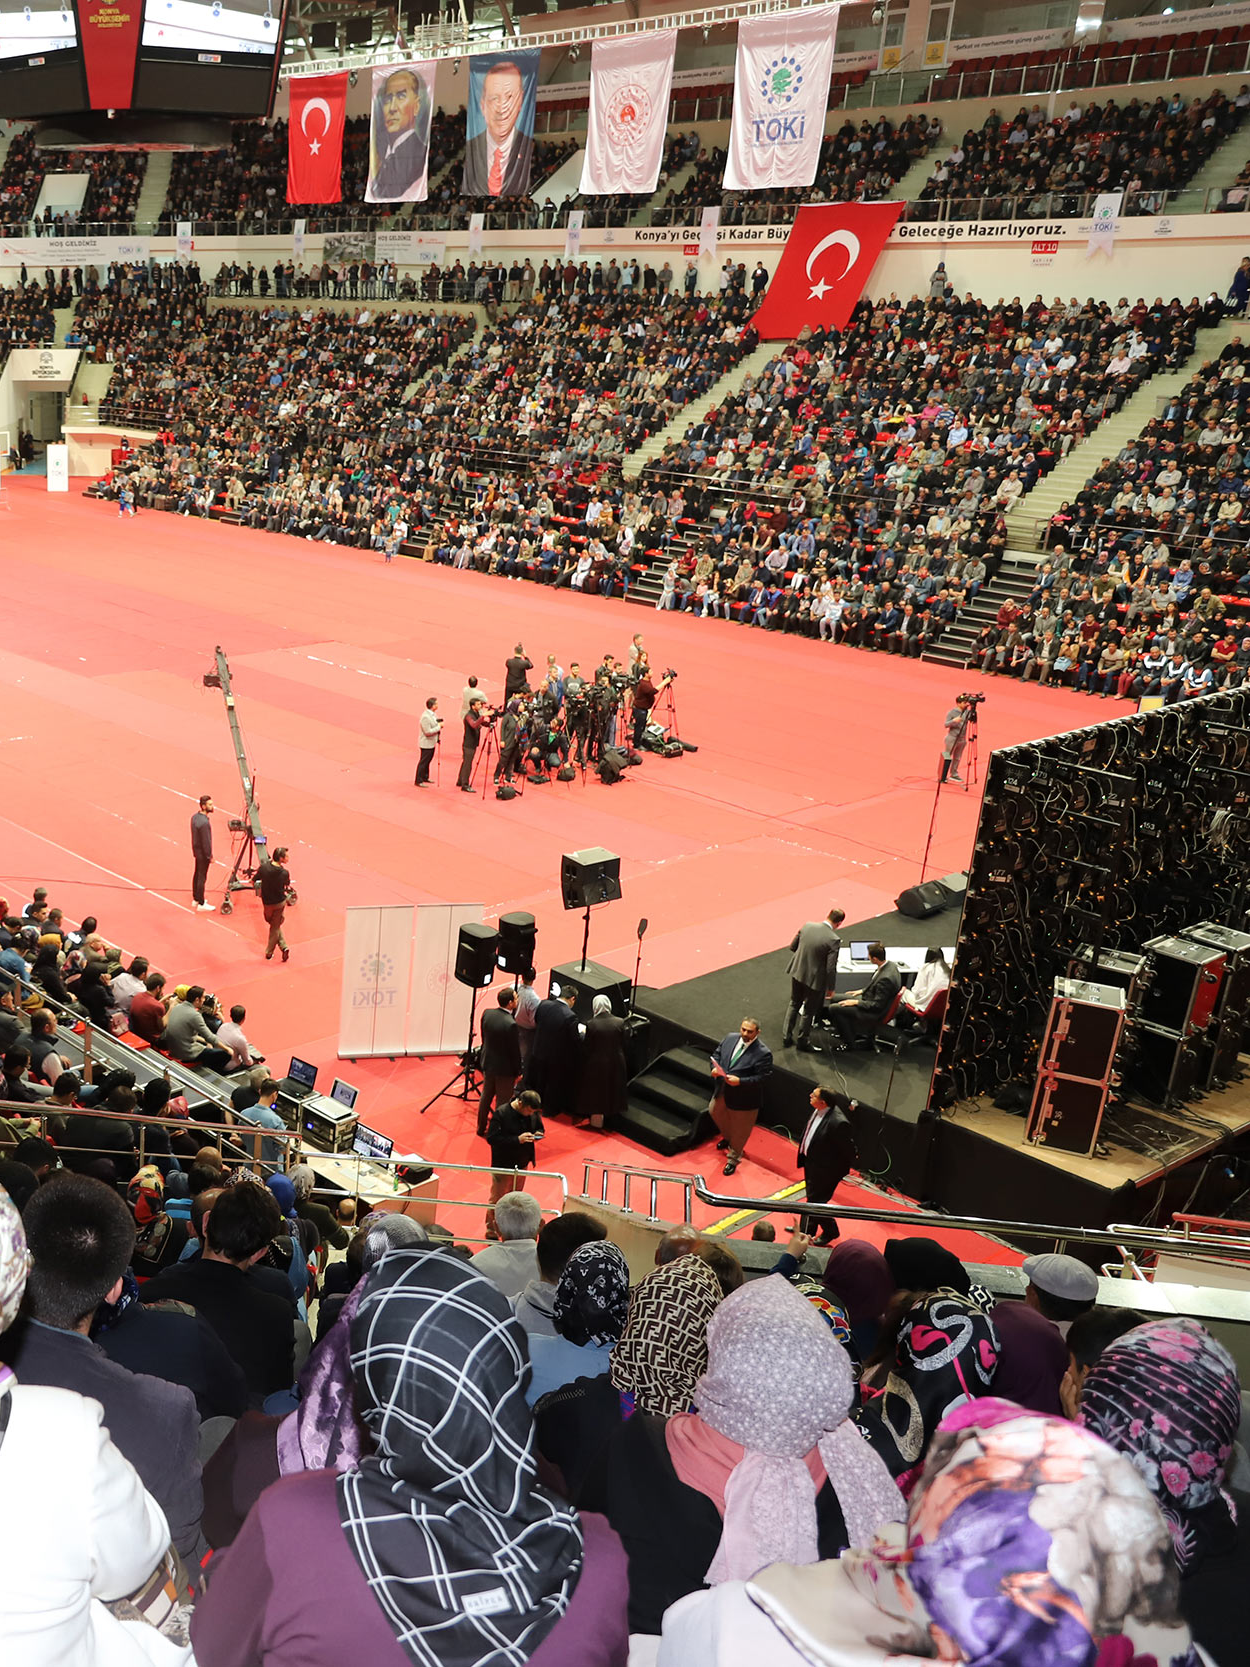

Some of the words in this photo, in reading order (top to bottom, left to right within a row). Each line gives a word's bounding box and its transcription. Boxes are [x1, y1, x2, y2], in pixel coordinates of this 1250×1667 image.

[682, 229, 726, 241] Geçşi
[729, 229, 764, 239] Kadar
[767, 227, 790, 241] Büy
[899, 224, 964, 239] Geleceğe
[968, 223, 1067, 238] Hazırlıyoruz.
[1032, 243, 1046, 251] ALT
[1047, 243, 1057, 251] 10
